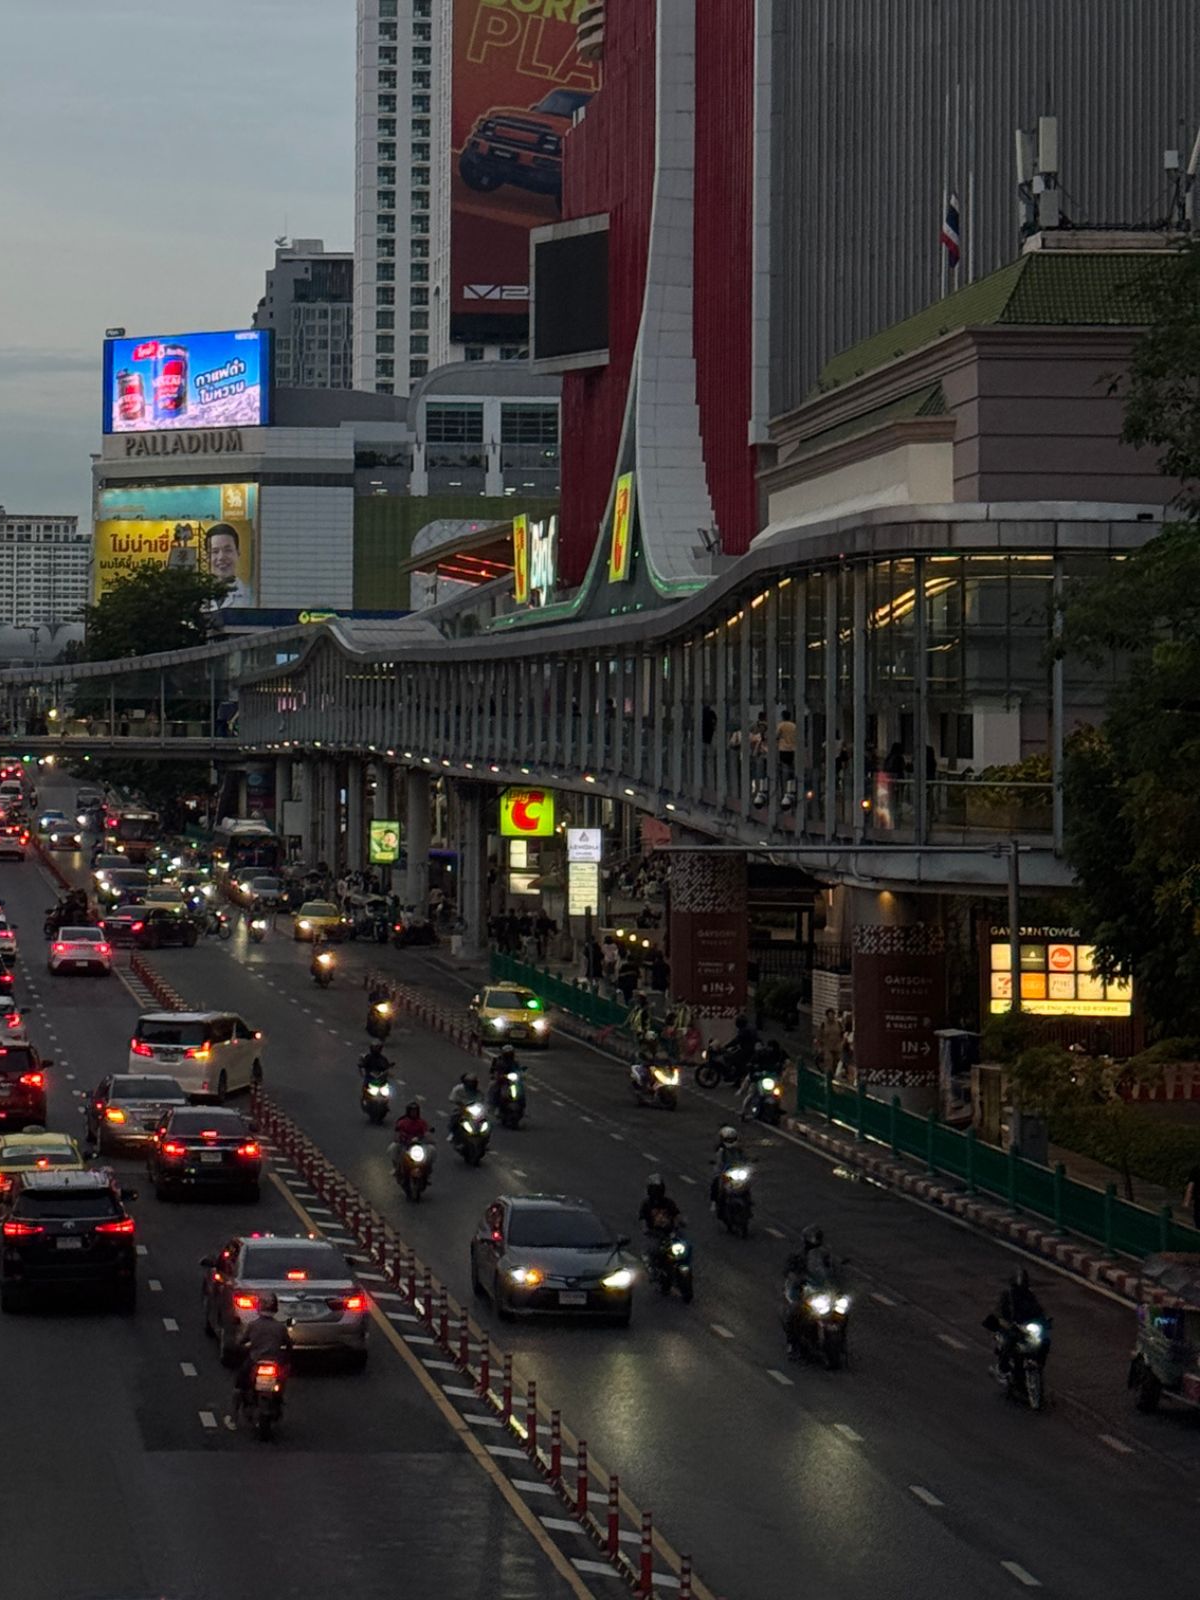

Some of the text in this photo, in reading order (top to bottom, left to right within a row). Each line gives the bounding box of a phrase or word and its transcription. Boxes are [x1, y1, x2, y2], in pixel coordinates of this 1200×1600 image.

[195, 358, 245, 387] กาแฟดำ
[199, 382, 245, 404] ไม่หวาน
[125, 430, 244, 457] PALLADIUM
[110, 528, 182, 553] ไม่น่าเชื่
[901, 1041, 919, 1054] IN
